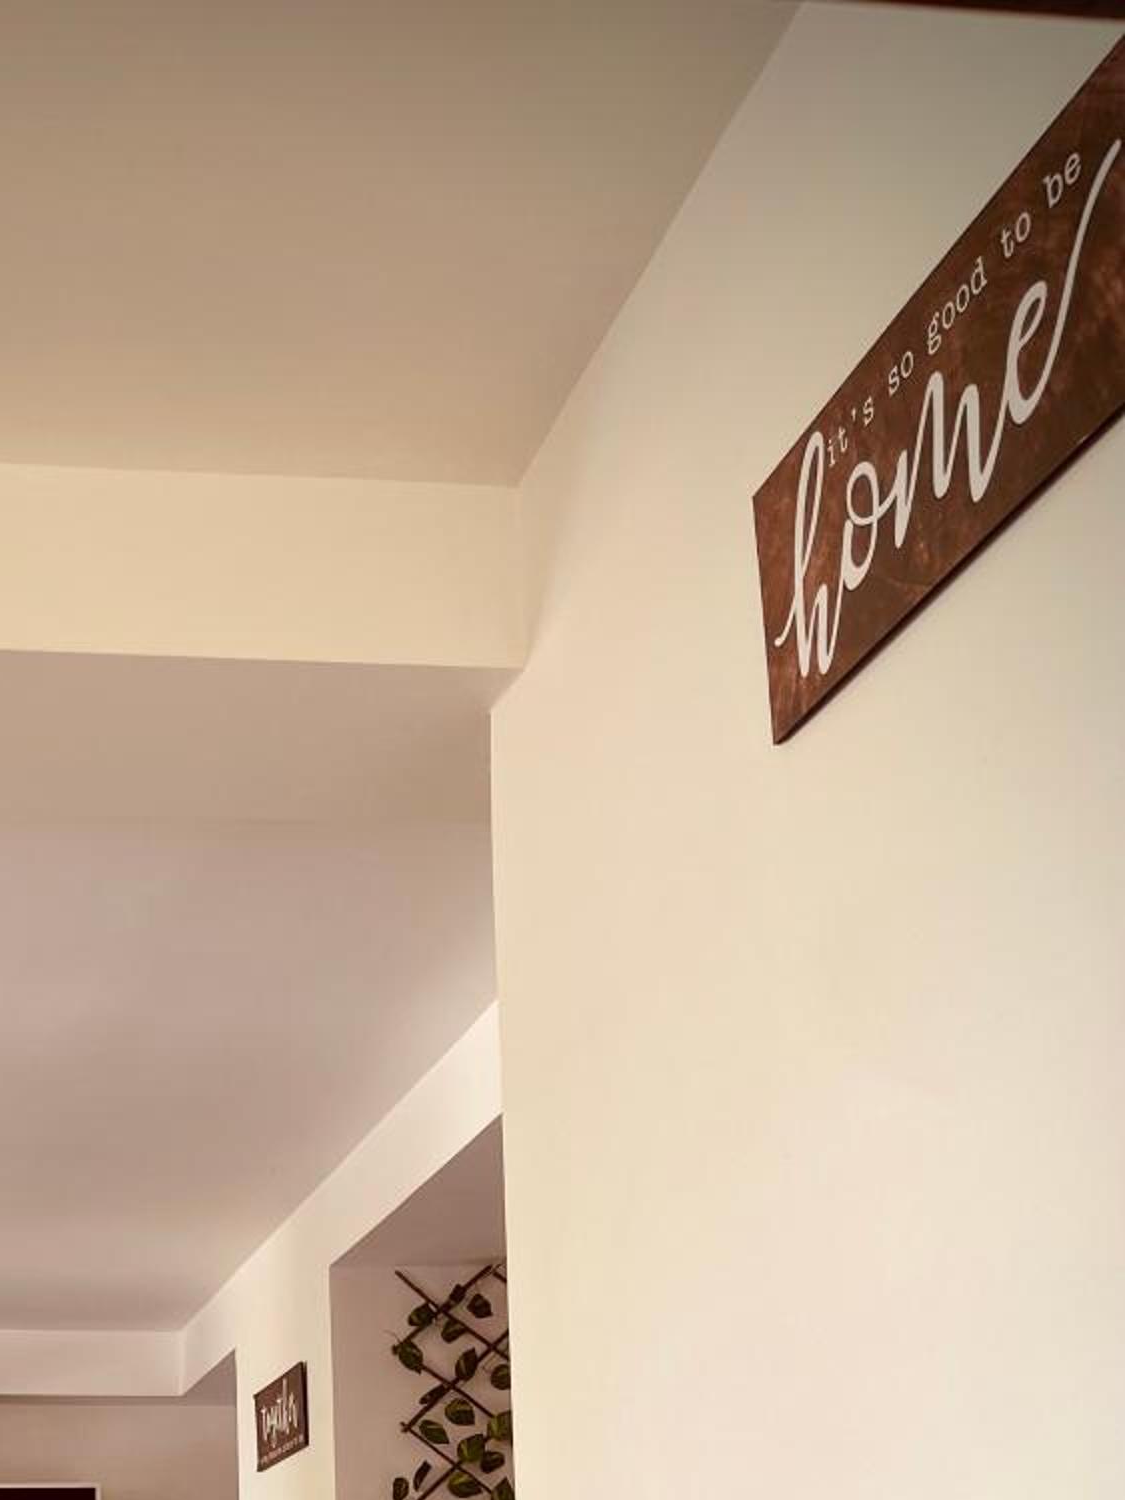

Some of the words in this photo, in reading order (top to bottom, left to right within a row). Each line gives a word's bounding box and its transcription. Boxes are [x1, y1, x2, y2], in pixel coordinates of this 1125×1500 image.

[775, 138, 1122, 679] home
[828, 396, 874, 466] it's
[888, 351, 914, 395] so
[927, 257, 988, 355] good
[1000, 212, 1031, 258] to
[1043, 152, 1082, 208] be
